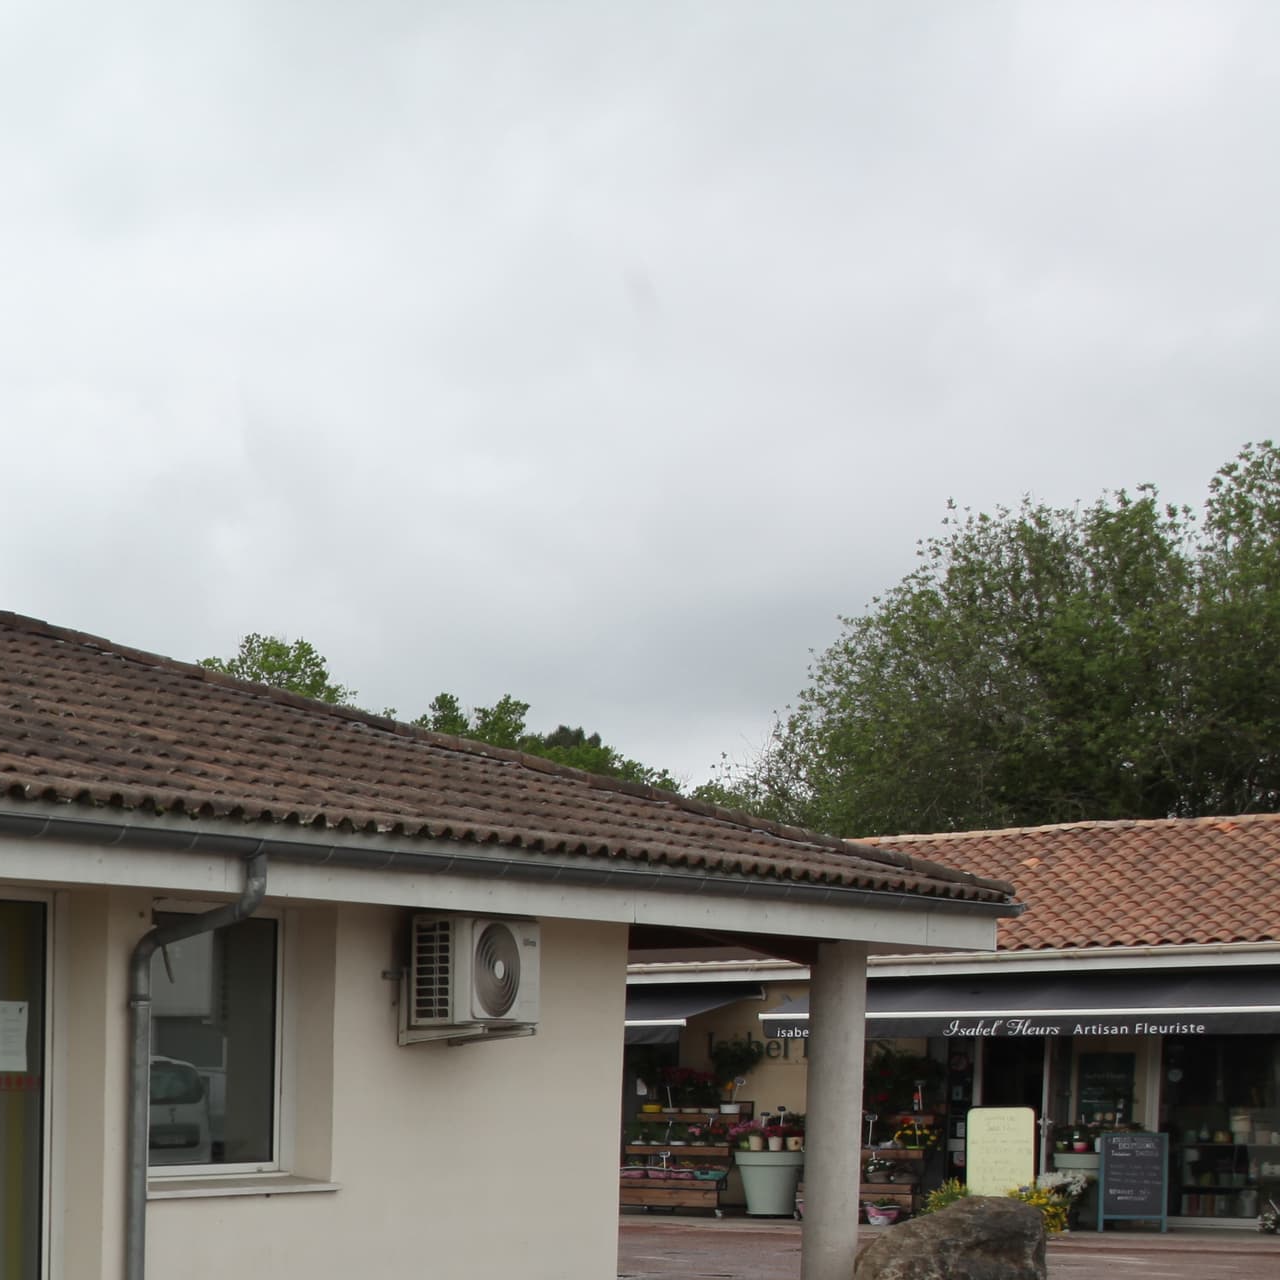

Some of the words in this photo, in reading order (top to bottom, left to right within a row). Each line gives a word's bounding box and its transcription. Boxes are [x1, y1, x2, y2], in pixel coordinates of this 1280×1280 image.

[1006, 1018, 1060, 1036] Fleurs
[1073, 1023, 1129, 1035] Artisan
[1135, 1022, 1206, 1034] Fleuriste
